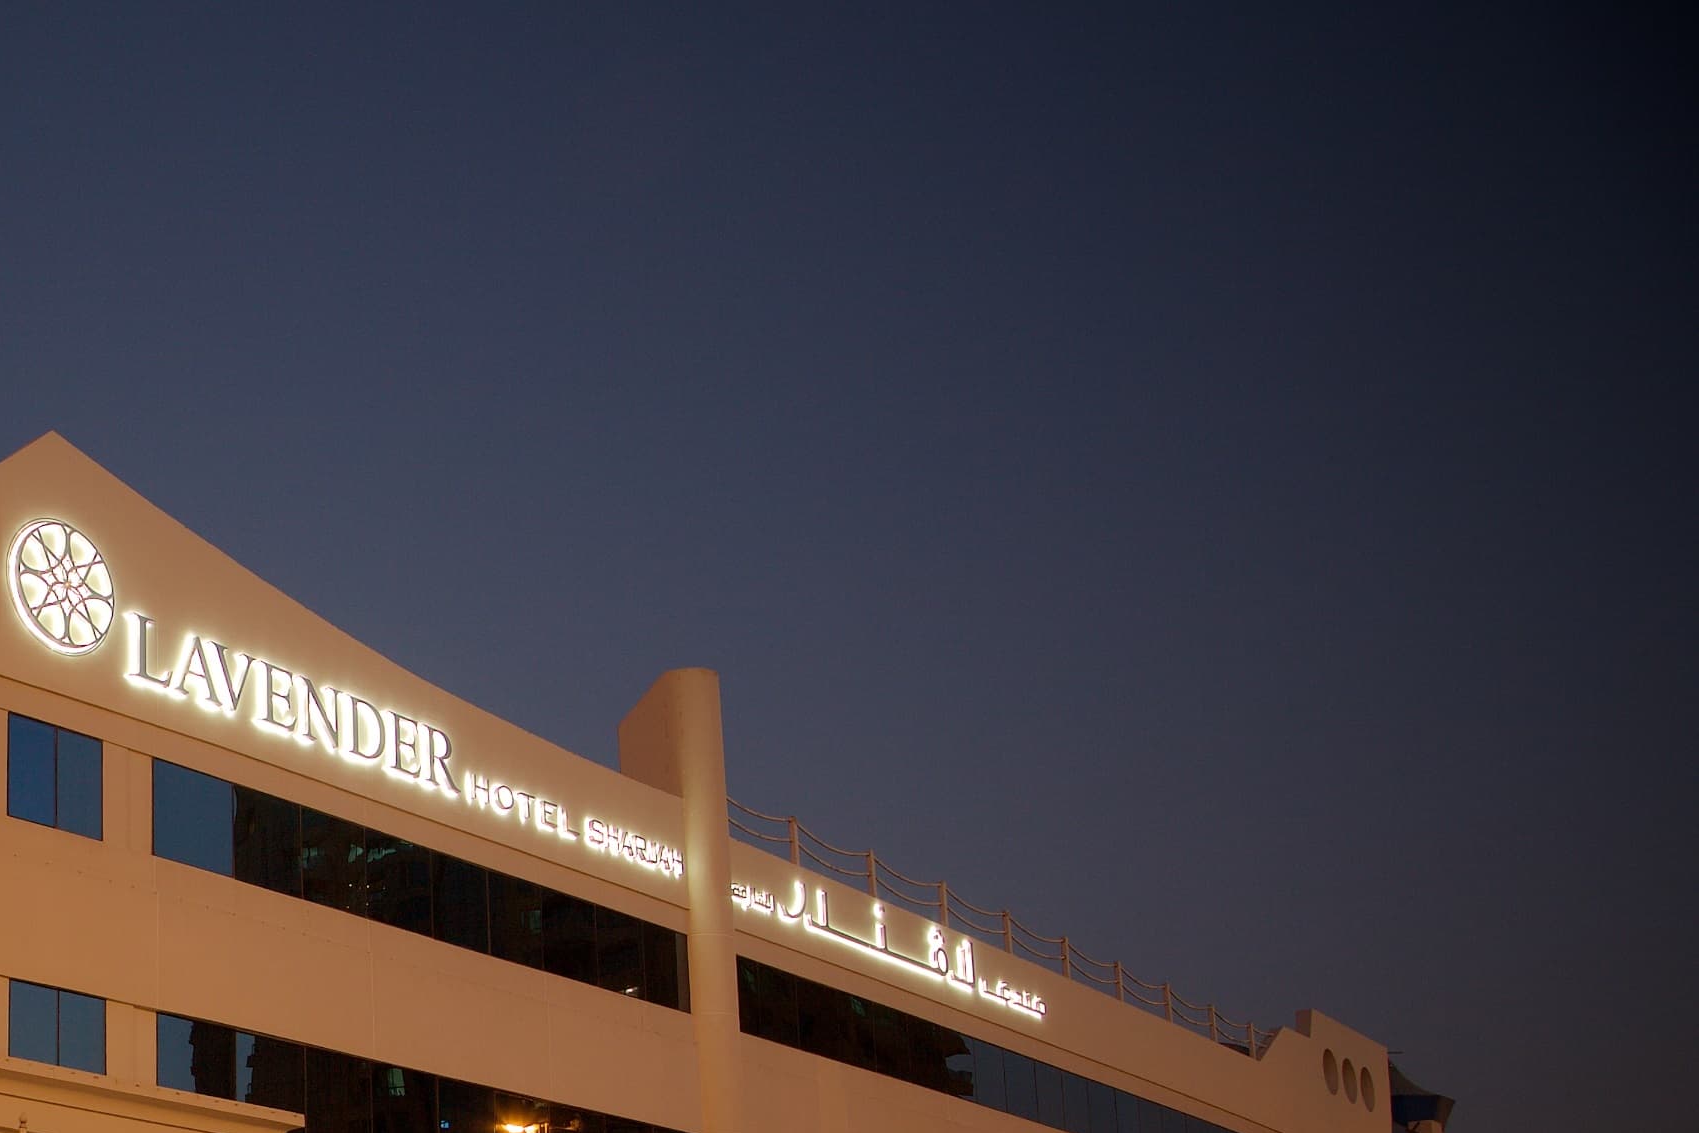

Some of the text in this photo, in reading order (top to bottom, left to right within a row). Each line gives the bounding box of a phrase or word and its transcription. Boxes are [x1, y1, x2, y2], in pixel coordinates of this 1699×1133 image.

[123, 610, 685, 879] LAVENDER HOTEL SHARJAH
